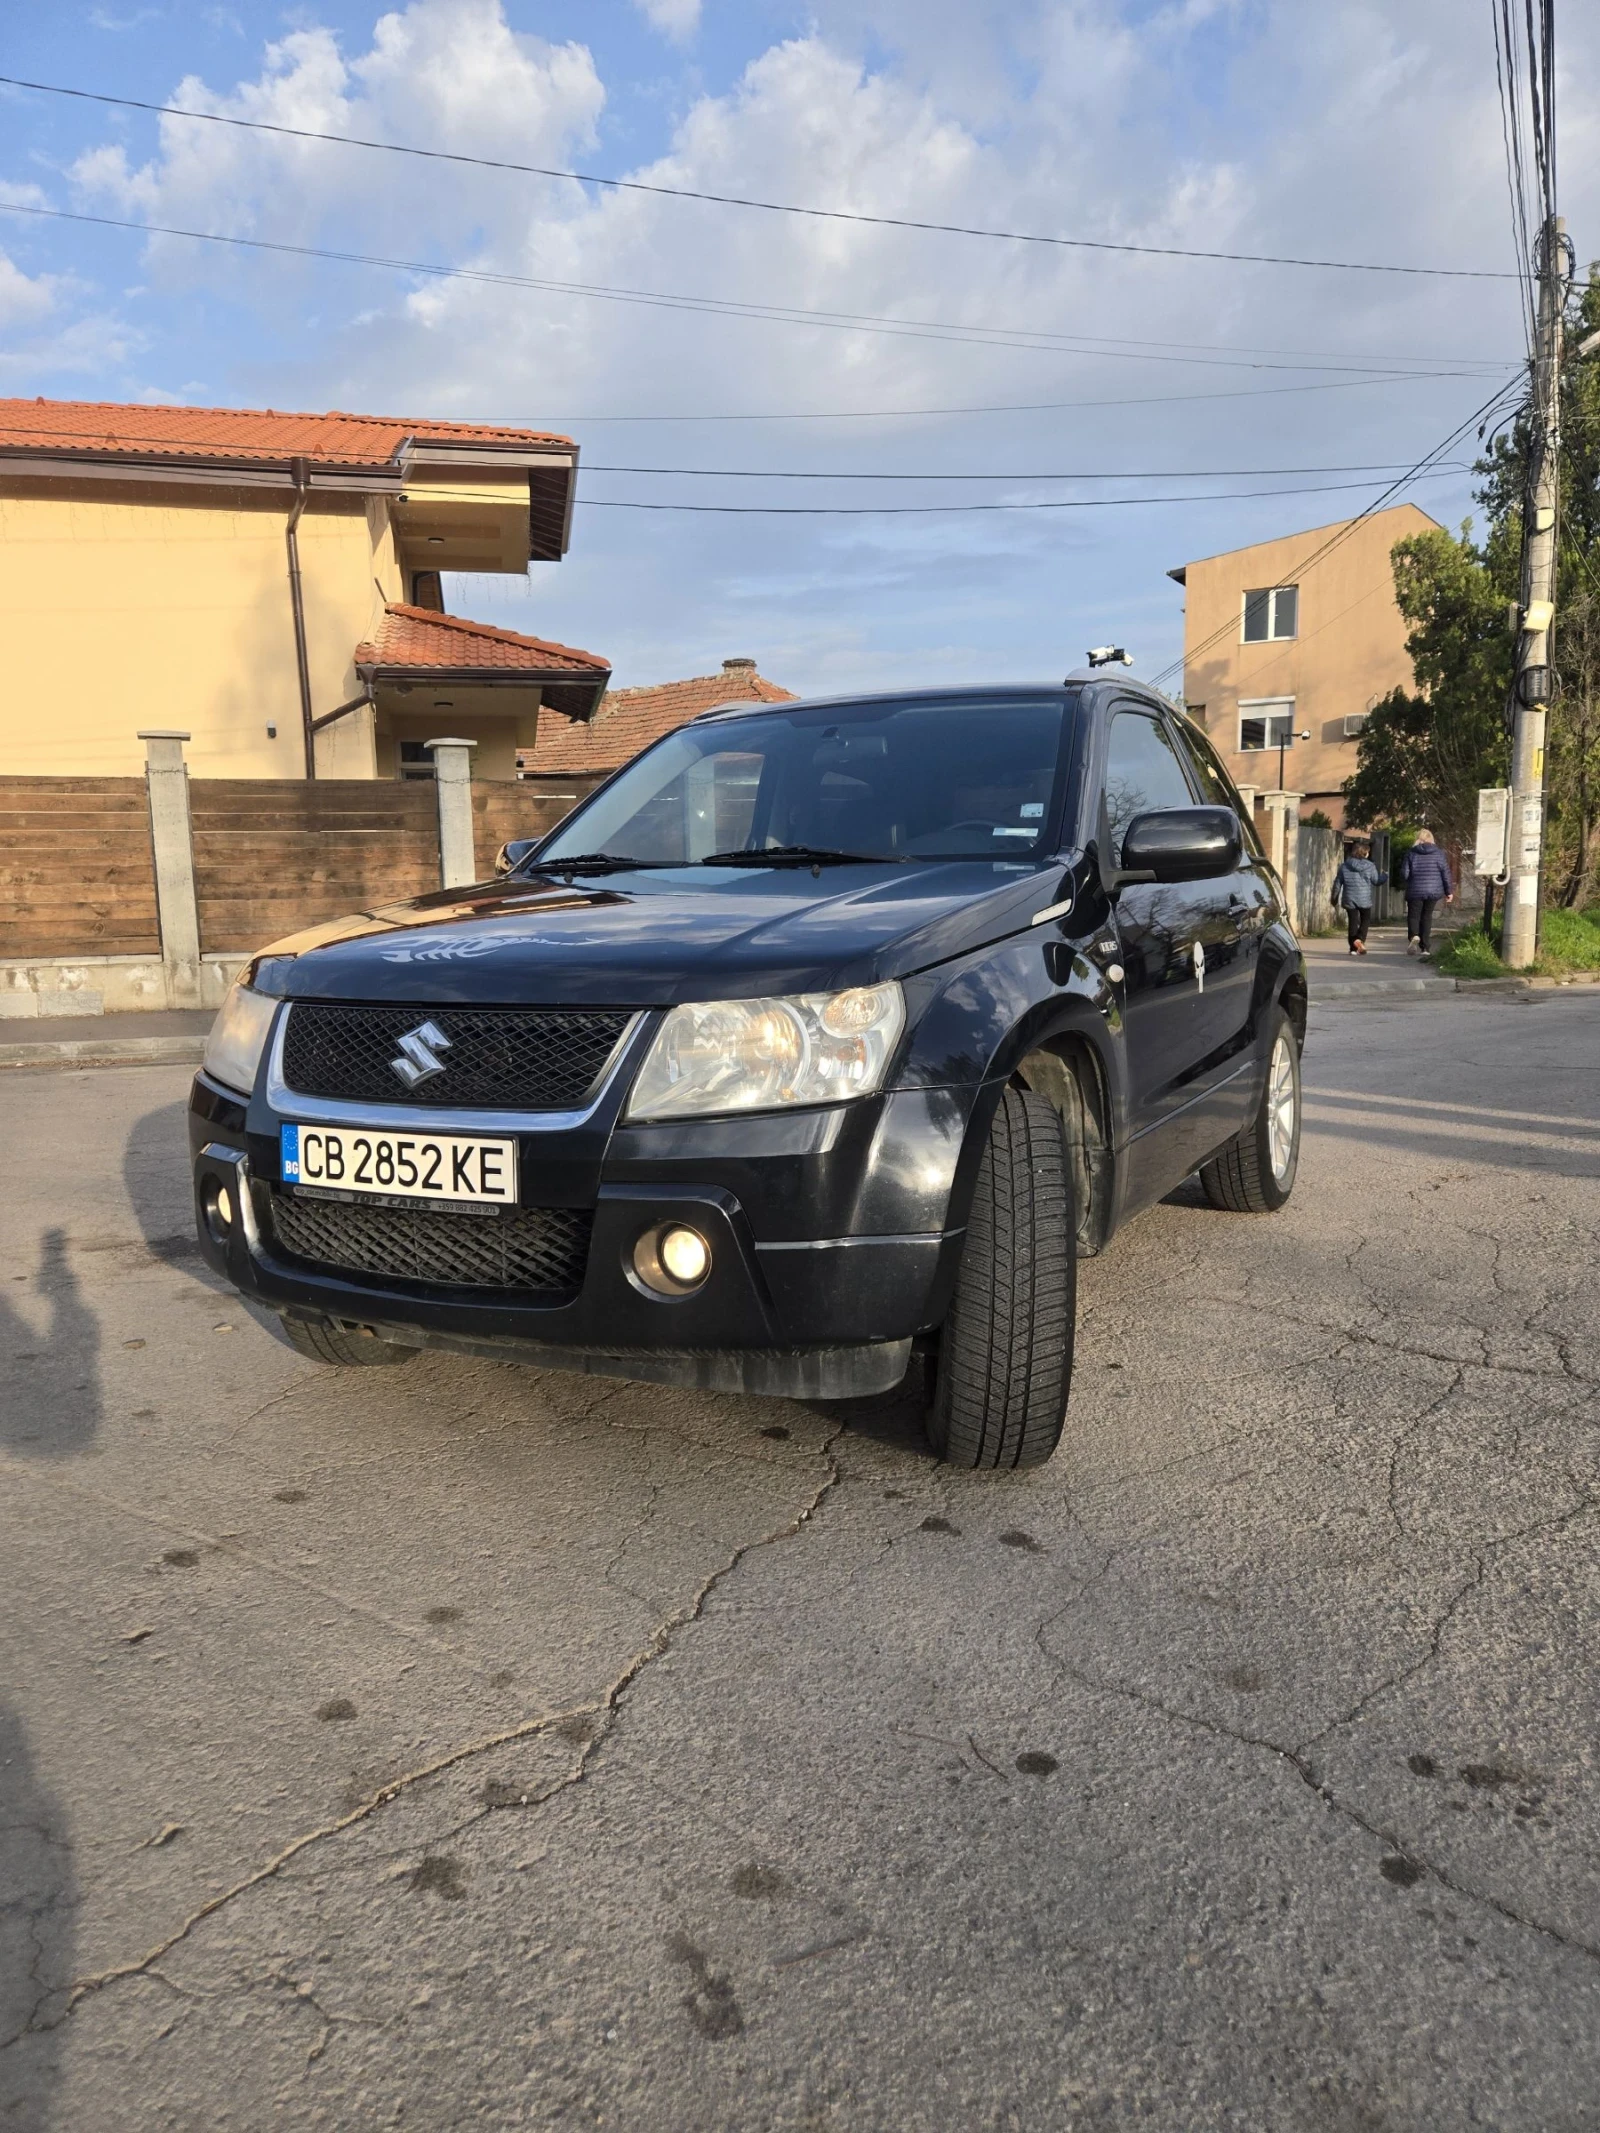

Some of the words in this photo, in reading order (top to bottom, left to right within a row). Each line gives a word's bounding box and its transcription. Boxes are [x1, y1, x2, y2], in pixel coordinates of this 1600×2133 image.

[285, 1160, 299, 1175] BG
[304, 1134, 345, 1180] CB
[353, 1138, 443, 1190] 2852
[452, 1145, 505, 1195] KE
[352, 1193, 382, 1205] TOP
[388, 1198, 431, 1210] CARS
[438, 1202, 454, 1211] +359
